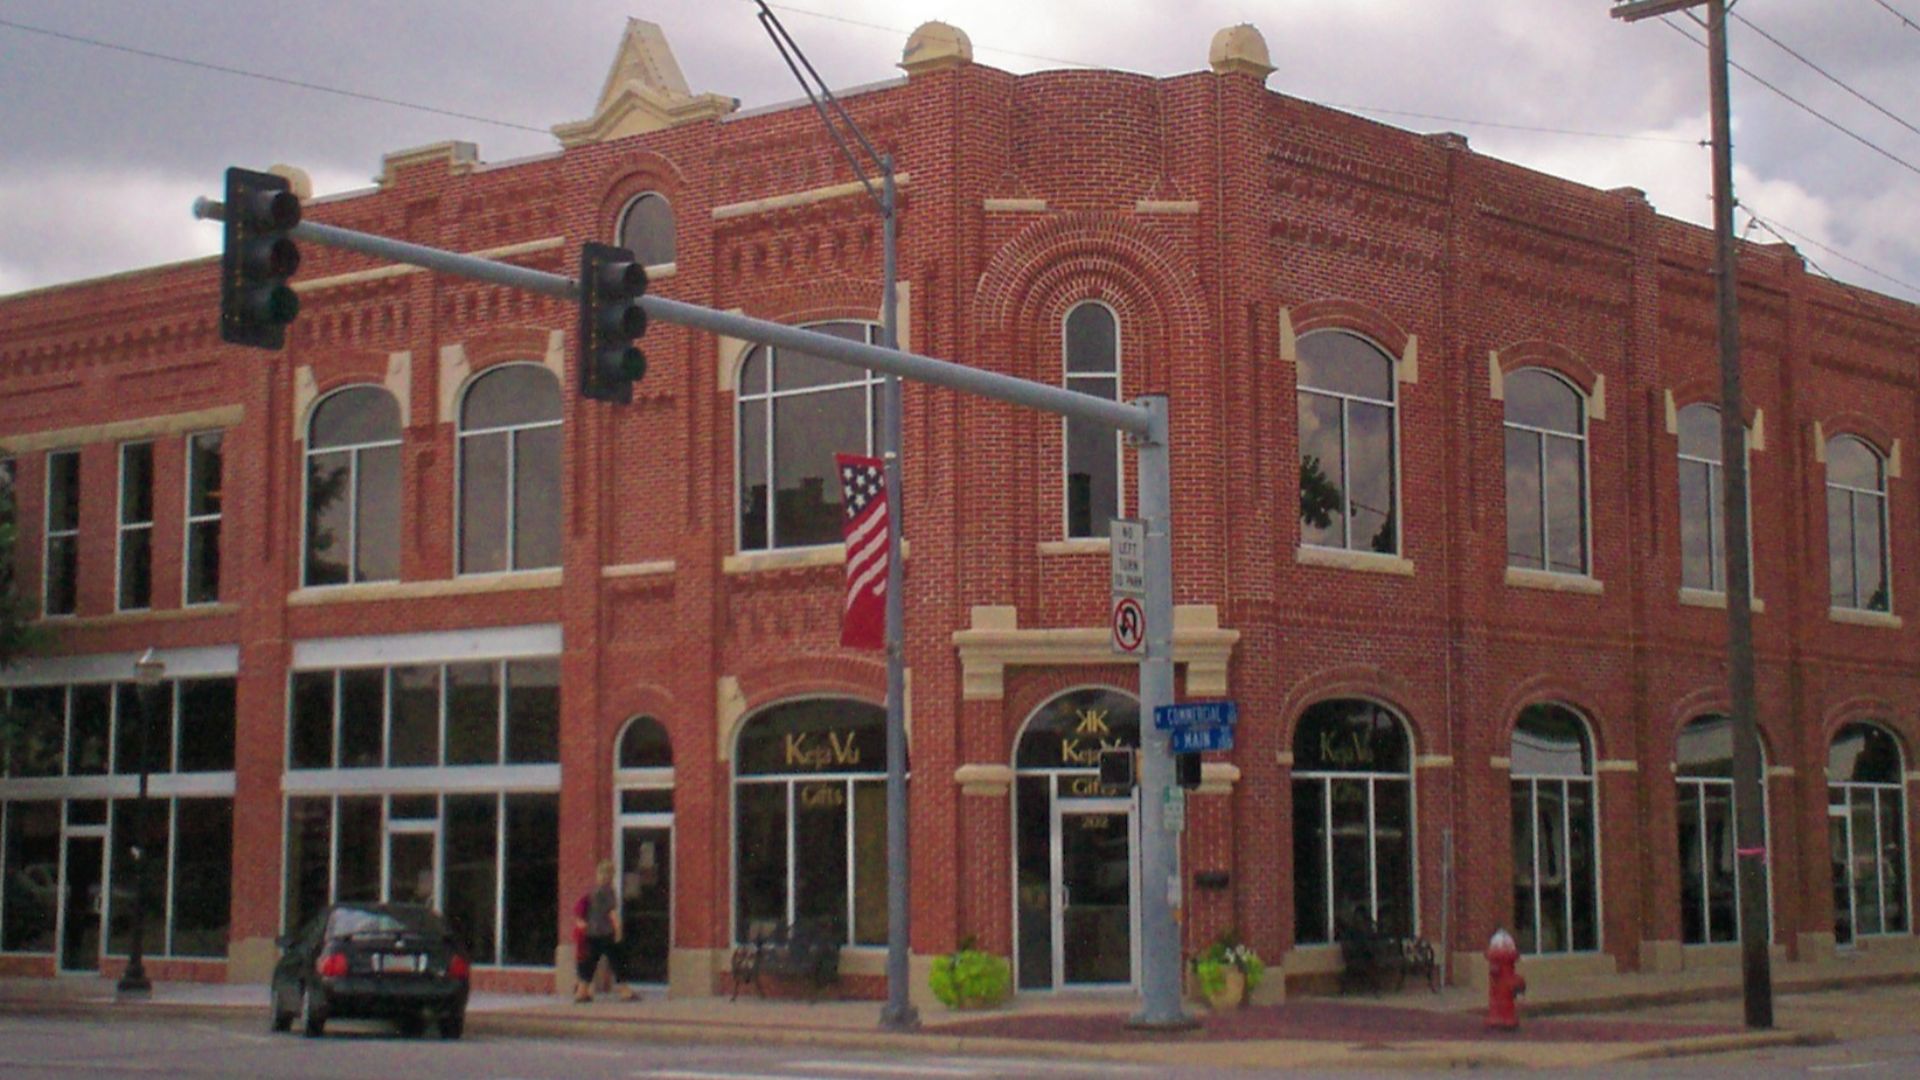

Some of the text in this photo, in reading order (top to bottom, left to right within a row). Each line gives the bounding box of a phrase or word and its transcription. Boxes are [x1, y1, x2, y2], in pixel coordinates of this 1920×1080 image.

[1119, 542, 1137, 555] LEFT
[1167, 705, 1222, 726] COMMERCIAL
[1184, 731, 1211, 749] MAIN
